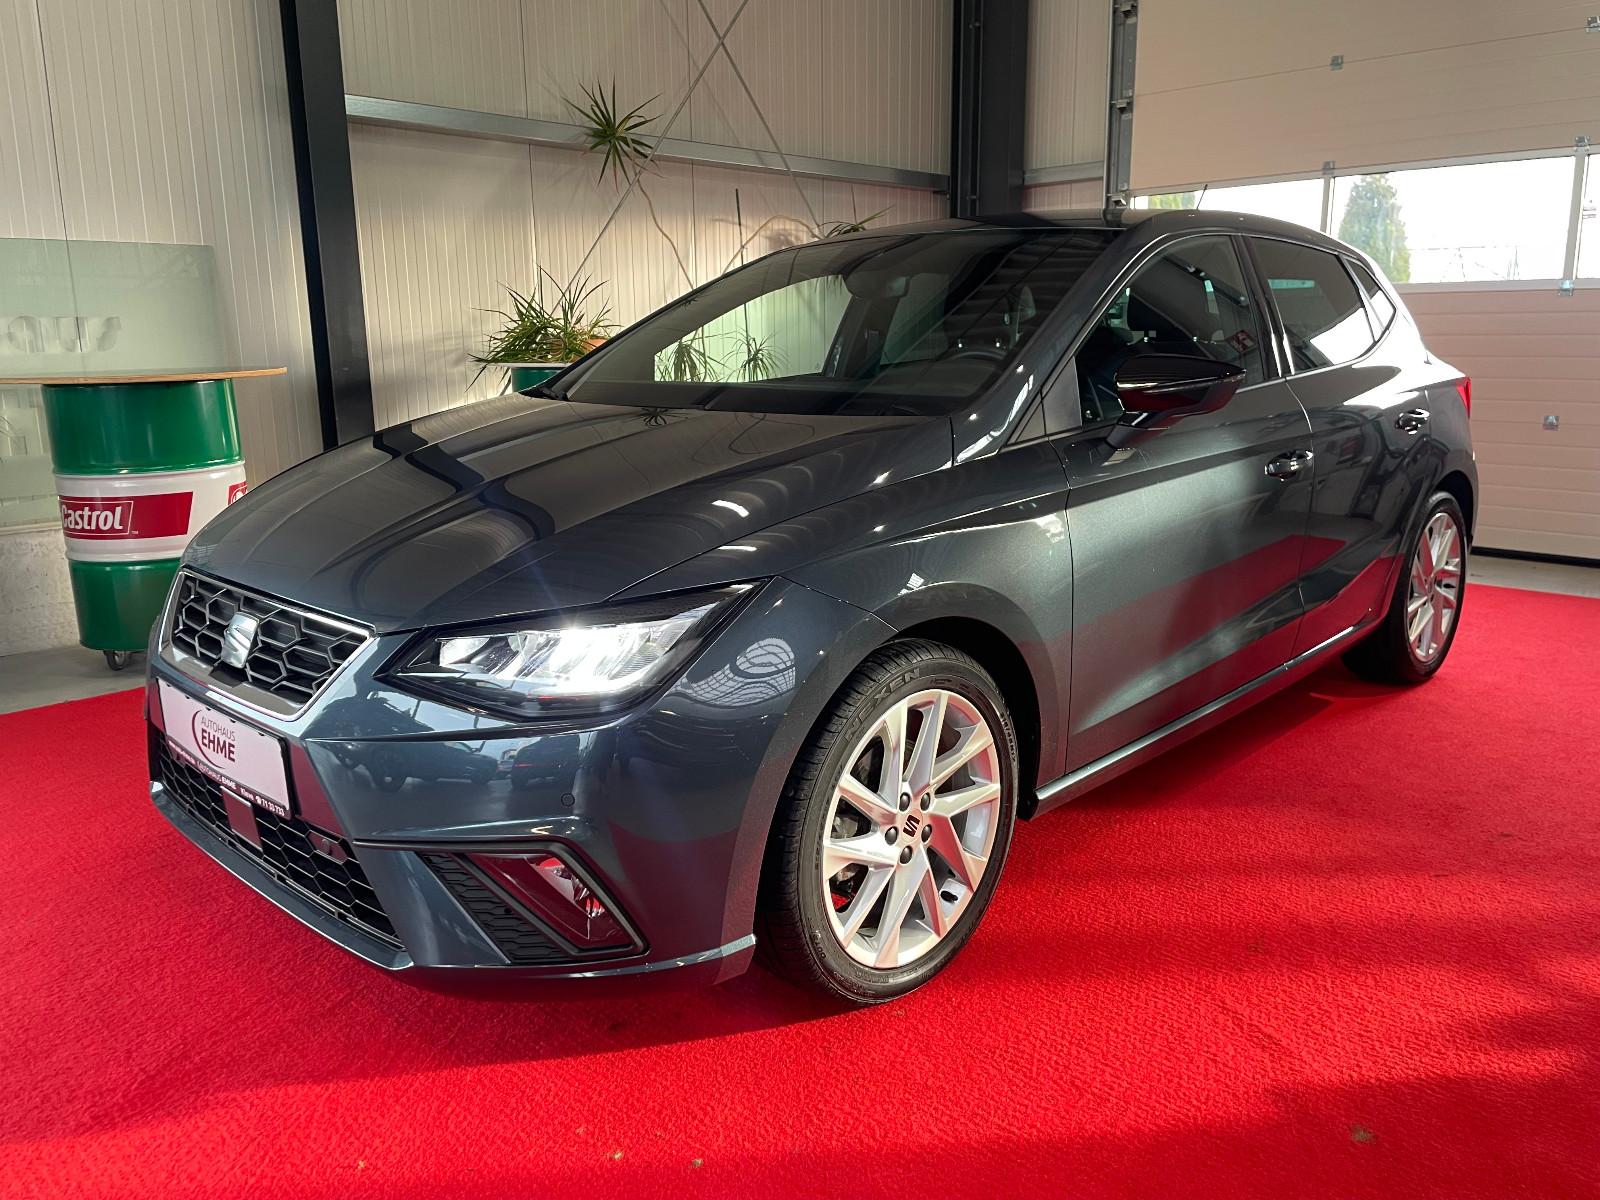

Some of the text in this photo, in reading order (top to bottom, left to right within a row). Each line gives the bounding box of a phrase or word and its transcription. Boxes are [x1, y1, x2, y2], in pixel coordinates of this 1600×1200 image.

[61, 504, 123, 531] Castrol
[843, 667, 920, 742] NEXEN
[201, 716, 236, 742] AUTOHAUS
[201, 730, 236, 762] EHME
